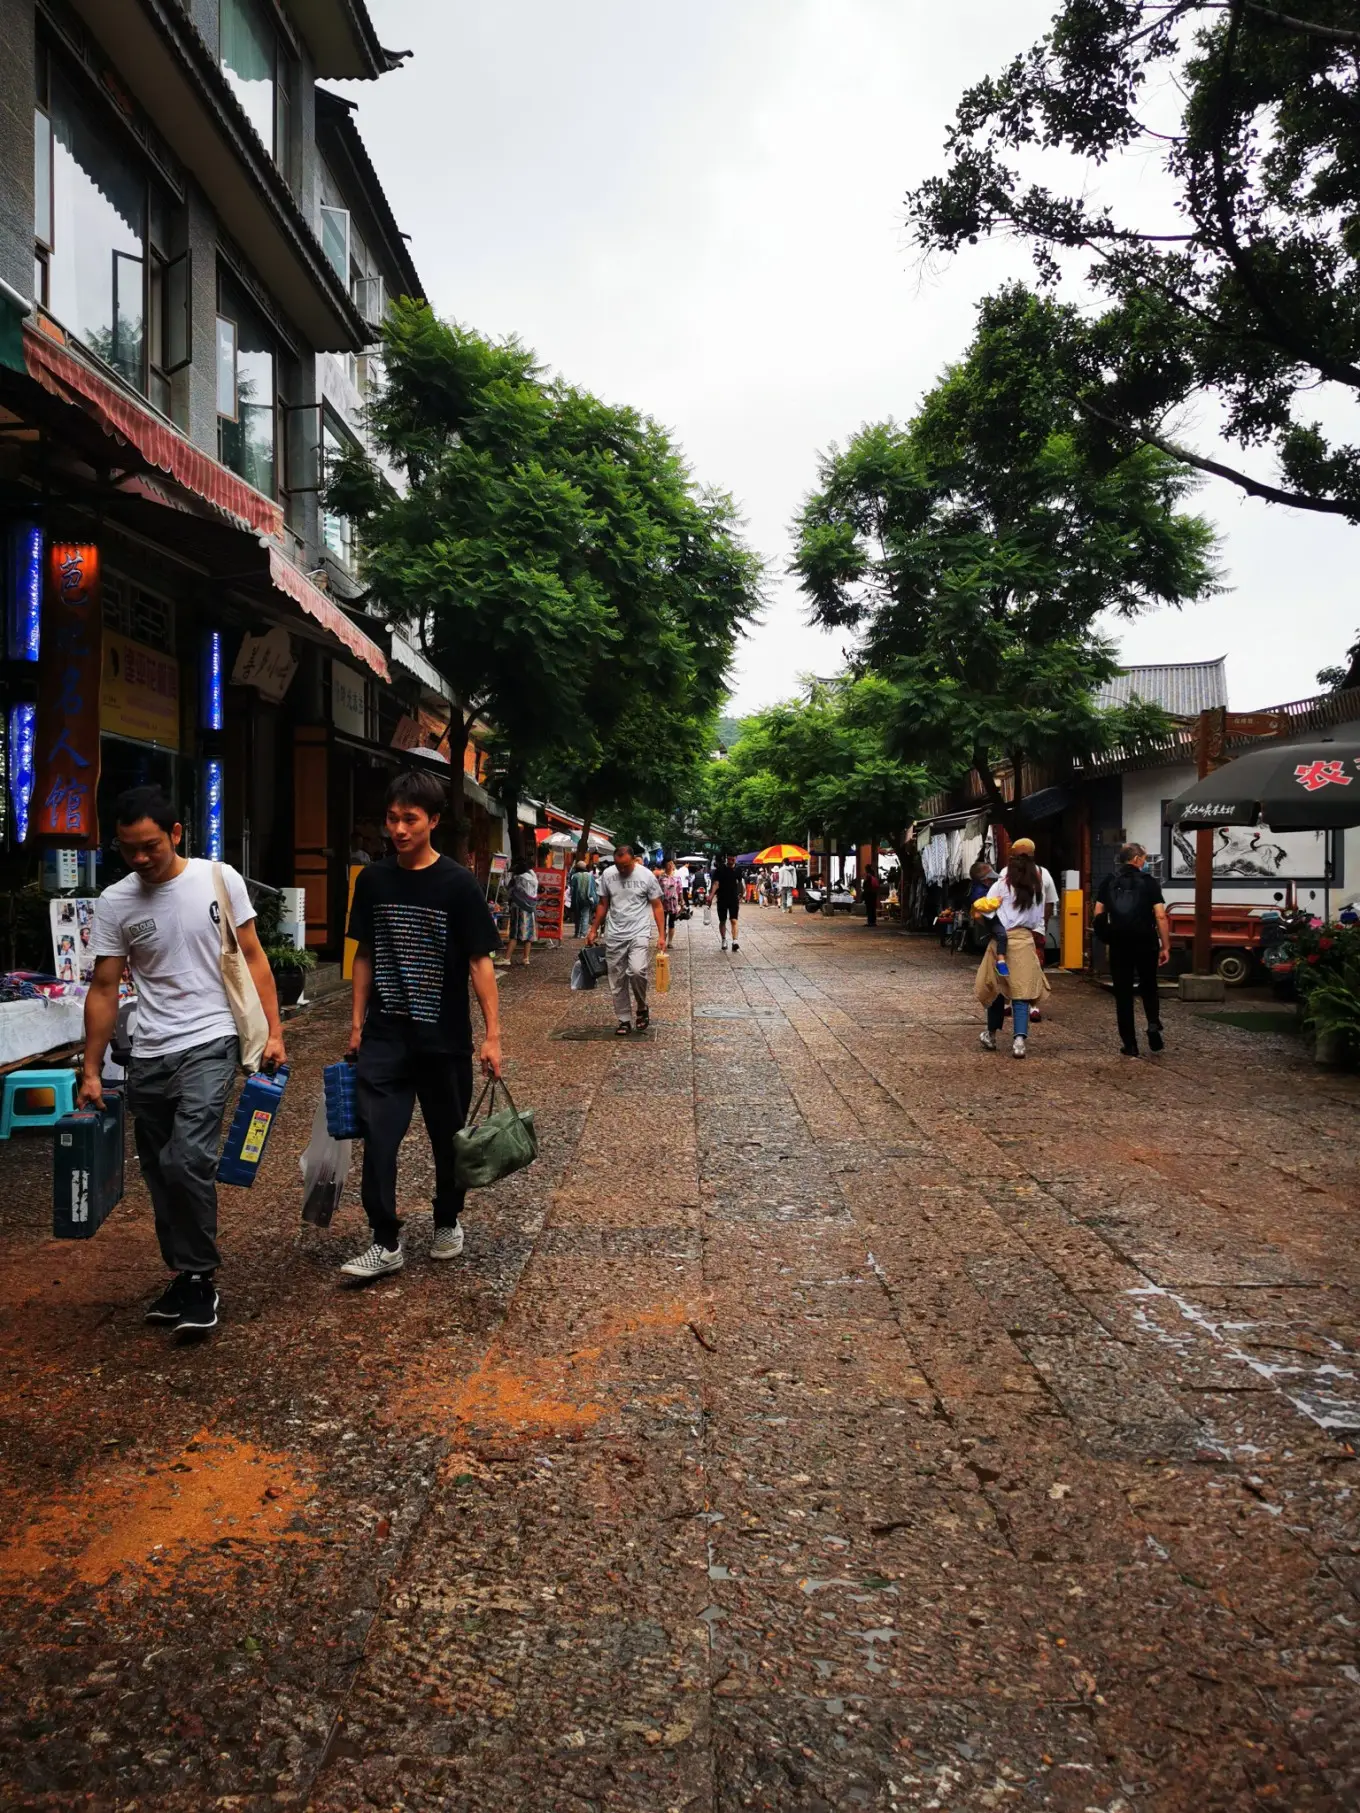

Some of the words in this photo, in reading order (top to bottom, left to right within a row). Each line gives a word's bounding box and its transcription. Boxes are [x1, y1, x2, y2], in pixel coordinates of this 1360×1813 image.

[45, 550, 91, 831] 芭名人馆
[1293, 757, 1360, 791] 农
